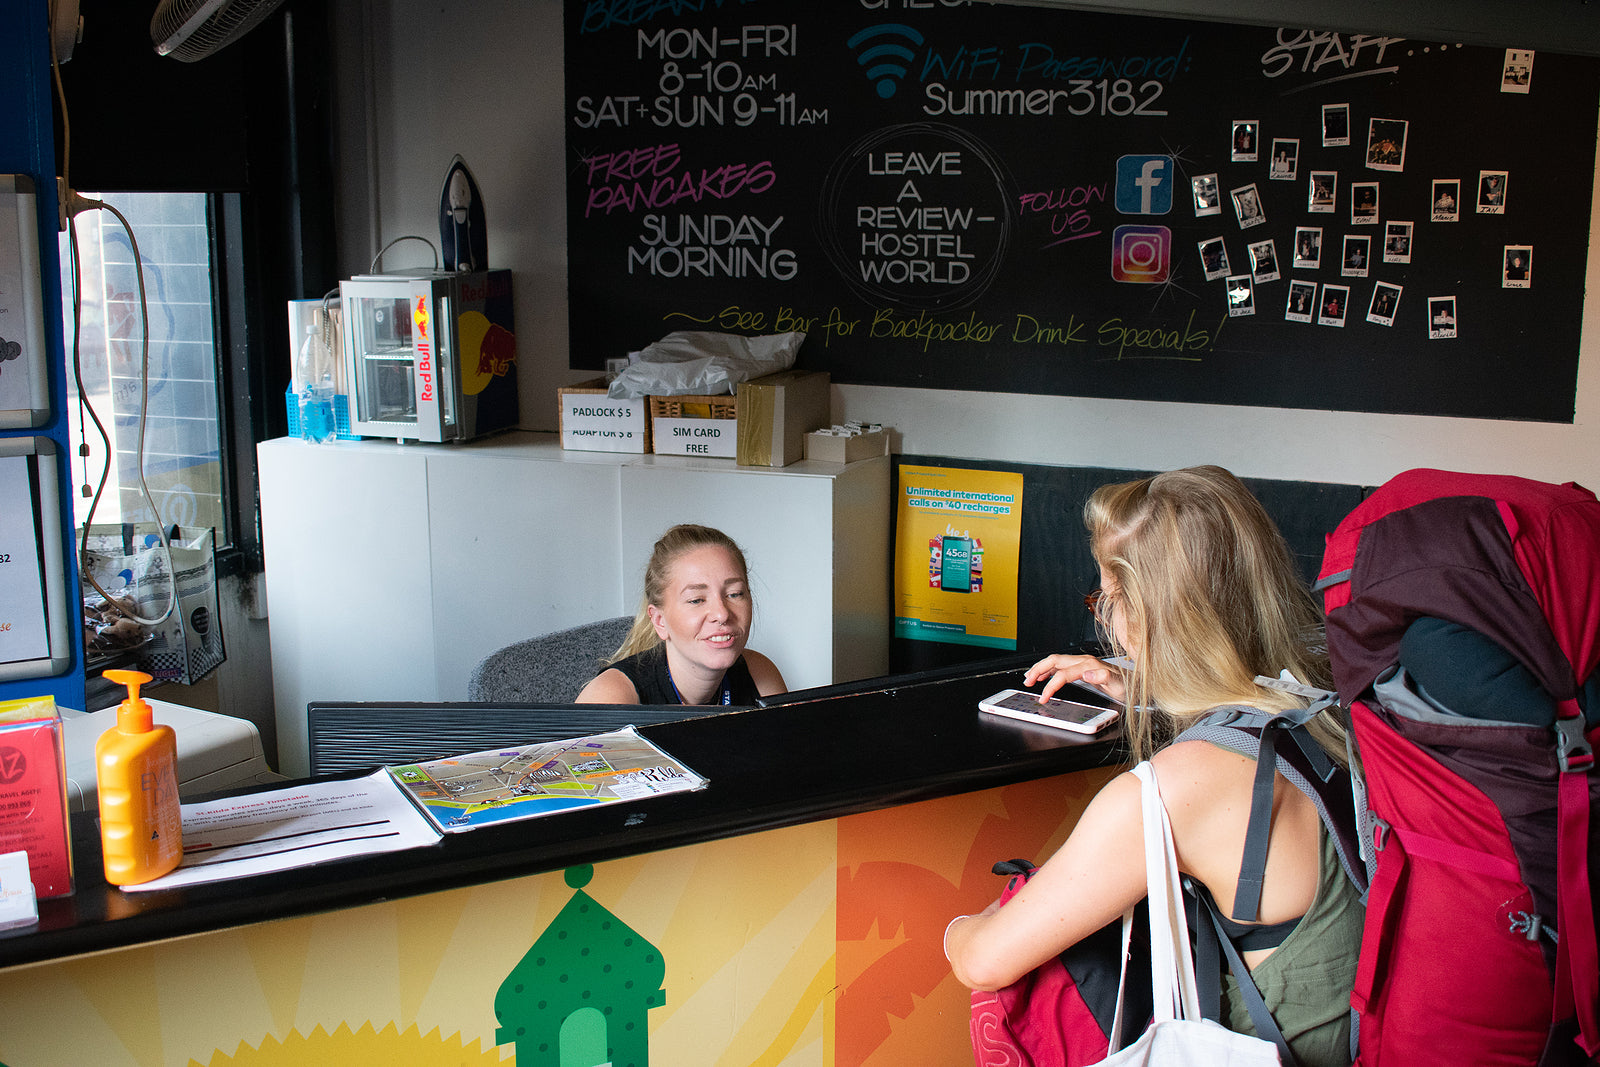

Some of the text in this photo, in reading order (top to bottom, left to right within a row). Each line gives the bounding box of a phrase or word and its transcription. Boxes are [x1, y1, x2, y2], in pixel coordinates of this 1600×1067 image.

[637, 24, 796, 59] MON-FRI
[920, 35, 1193, 82] WiFi Password:
[922, 79, 1168, 117] Summer3182
[585, 143, 681, 186] FREE
[868, 152, 962, 175] LEAVE
[585, 161, 776, 218] PANCAKES
[896, 180, 922, 203] A
[1018, 182, 1108, 216] FOLLOW
[639, 214, 784, 247] SUNDAY
[1051, 209, 1092, 236] US
[862, 233, 975, 259] HOSTEL
[627, 246, 798, 281] MORNING
[859, 260, 971, 284] WORLD
[719, 306, 1228, 361] See Bar for Backpacker Drink Specials!
[417, 343, 433, 402] Red Bull
[572, 407, 616, 418] PADLOCK
[673, 427, 721, 438] SIM CARD
[686, 444, 709, 454] FREE
[906, 486, 1015, 503] Unlimited international
[909, 498, 930, 507] calls
[931, 500, 944, 508] on
[963, 502, 1011, 515] recharges
